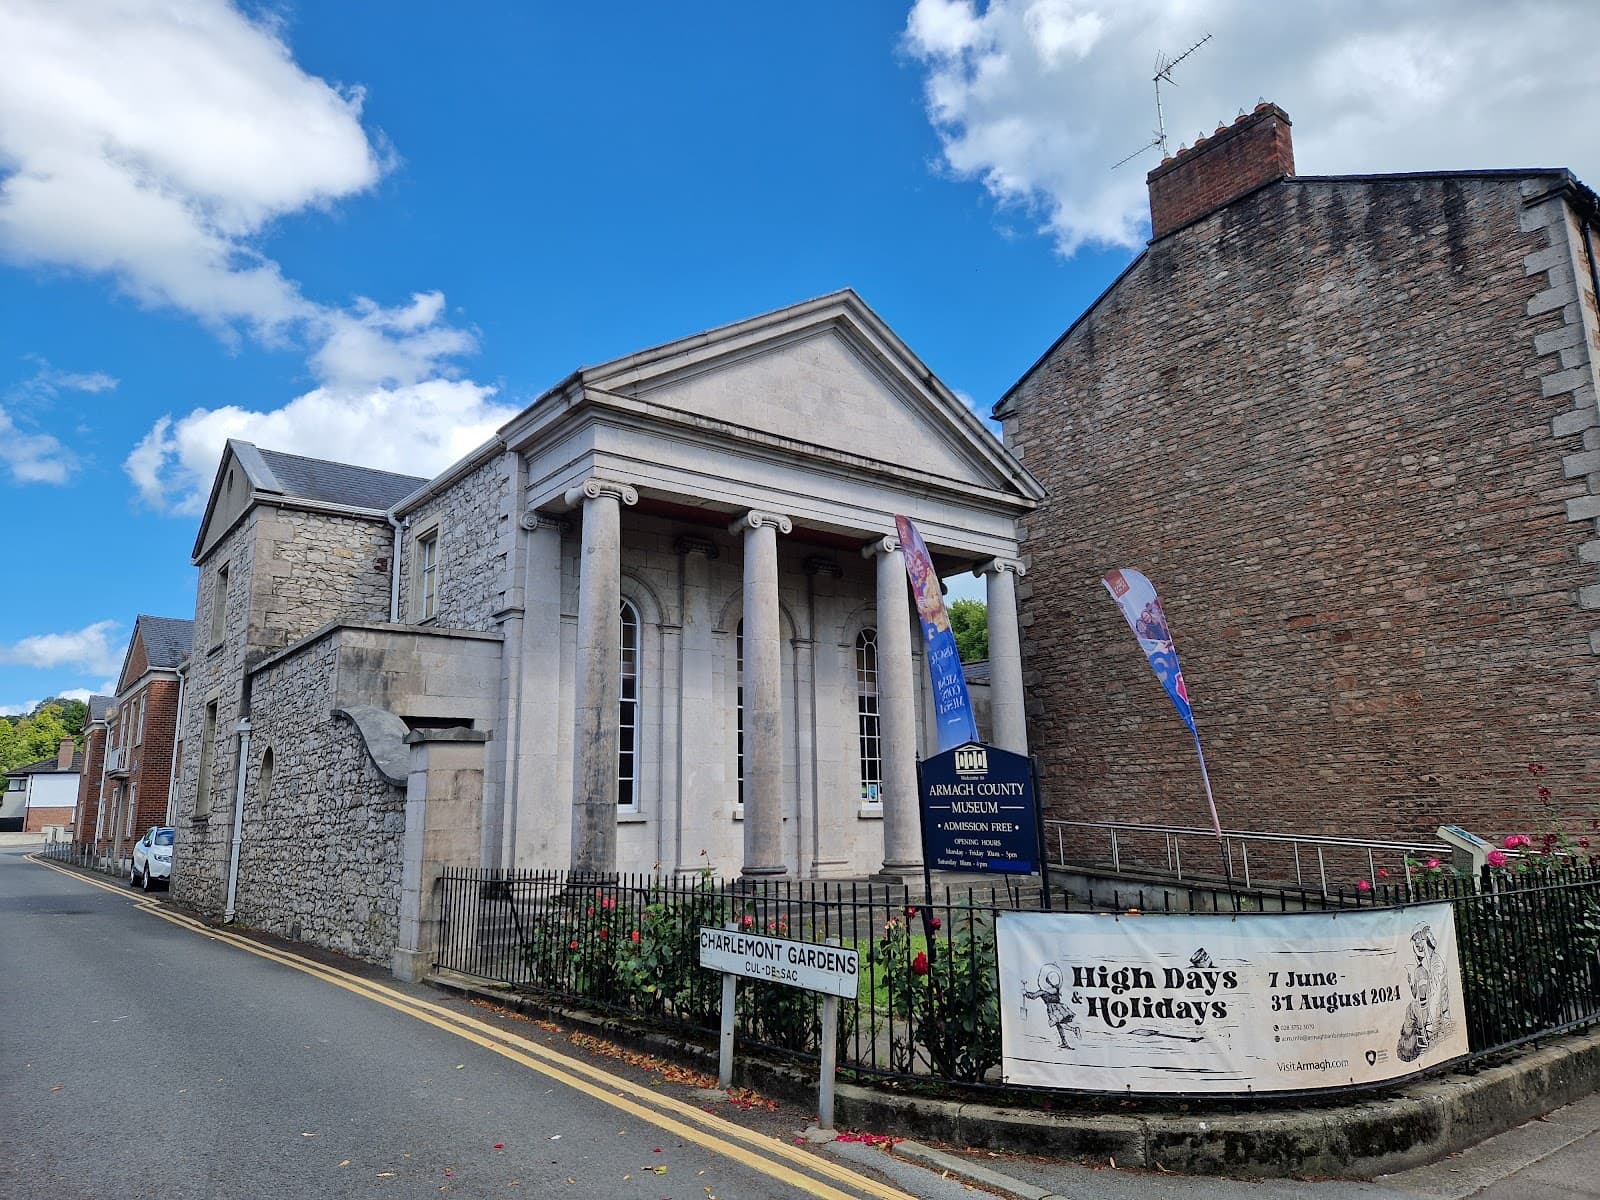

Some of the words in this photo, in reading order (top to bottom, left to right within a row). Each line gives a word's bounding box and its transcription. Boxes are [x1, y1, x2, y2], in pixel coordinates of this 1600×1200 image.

[929, 784, 974, 796] ARMAGH
[977, 783, 1024, 796] COUNTY
[951, 802, 998, 813] MUSEUM
[944, 822, 989, 831] ADMISSION
[991, 823, 1013, 832] FREE
[954, 838, 979, 846] OPENING
[945, 848, 963, 857] Monday
[969, 849, 984, 857] Friday
[700, 932, 782, 961] CHARLEMONT
[788, 946, 857, 975] GARDENS
[1071, 966, 1156, 995] High
[1162, 967, 1238, 996] Days
[1268, 971, 1279, 988] 7
[1271, 994, 1293, 1012] 31
[1299, 989, 1368, 1013] August
[1370, 985, 1401, 1004] 2024
[1071, 991, 1083, 1005] &
[1086, 996, 1228, 1028] Holidays
